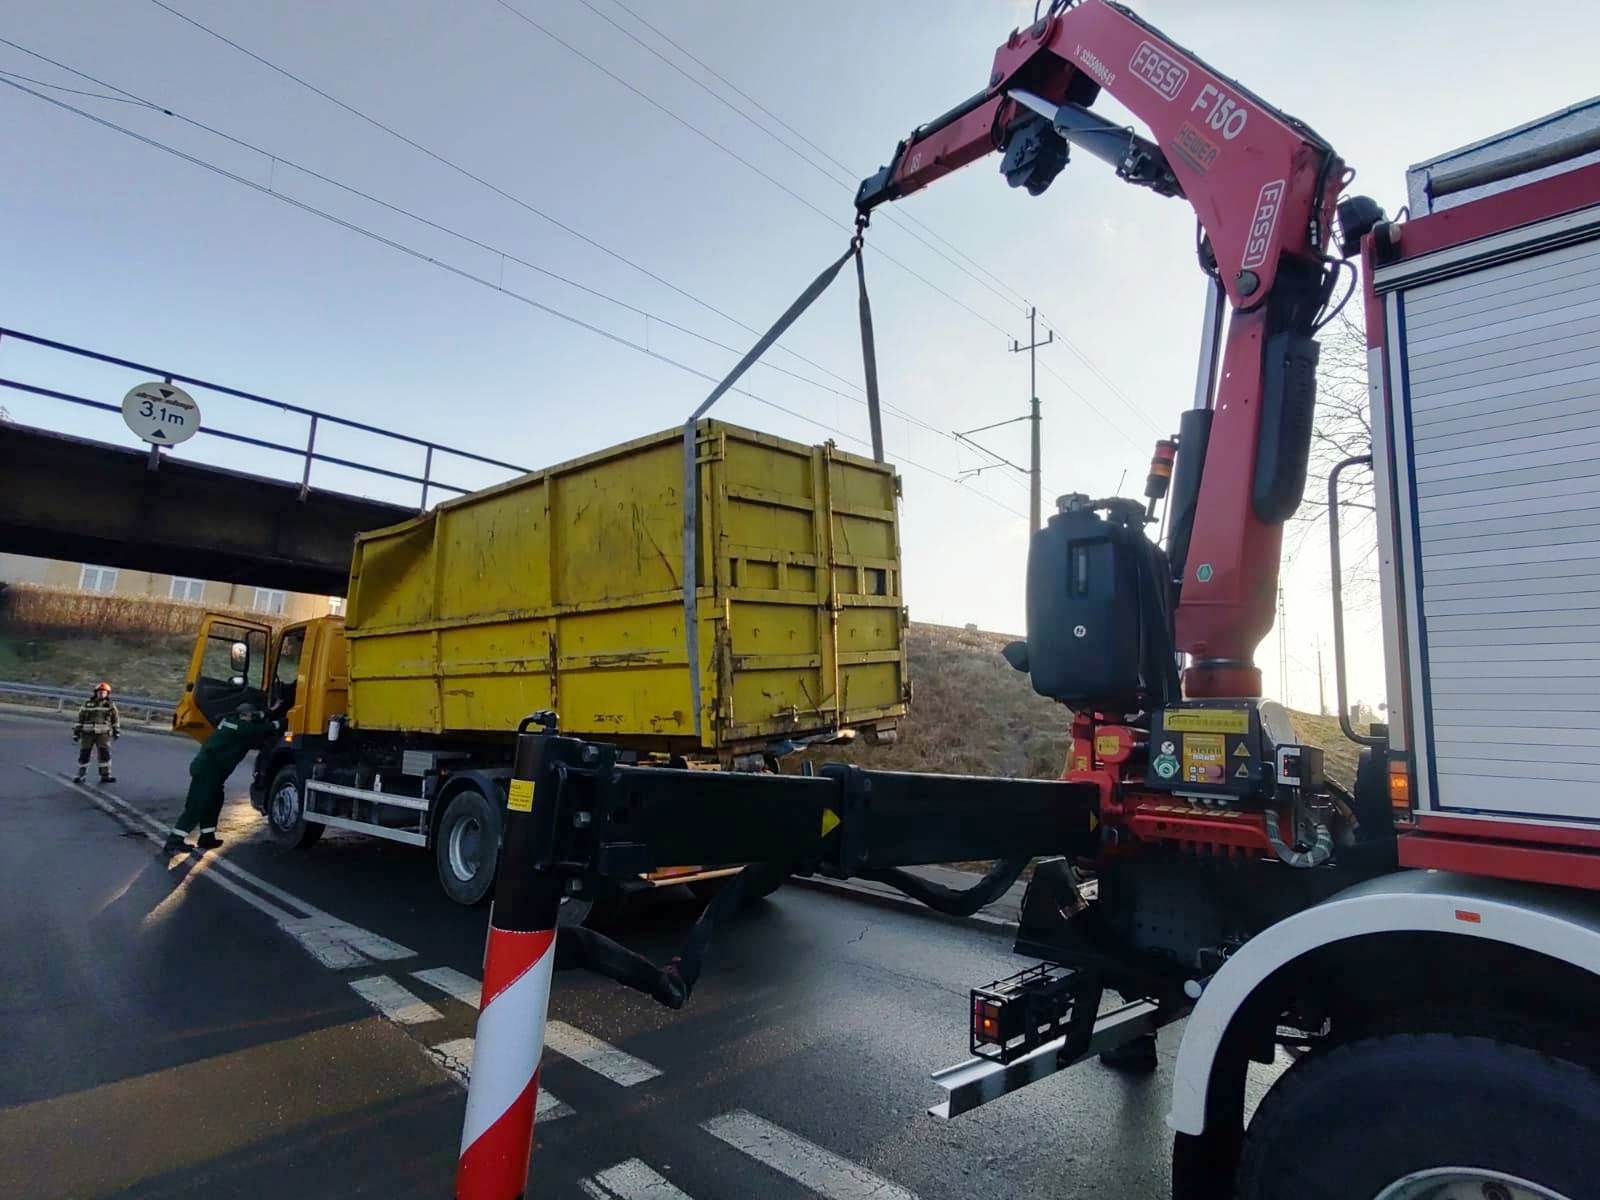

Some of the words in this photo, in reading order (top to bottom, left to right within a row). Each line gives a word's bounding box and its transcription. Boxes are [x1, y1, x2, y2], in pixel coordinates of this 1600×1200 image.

[1132, 45, 1185, 96] FASSI
[1191, 83, 1248, 140] F150
[1246, 187, 1280, 262] FASSI
[139, 400, 185, 426] 3,1m
